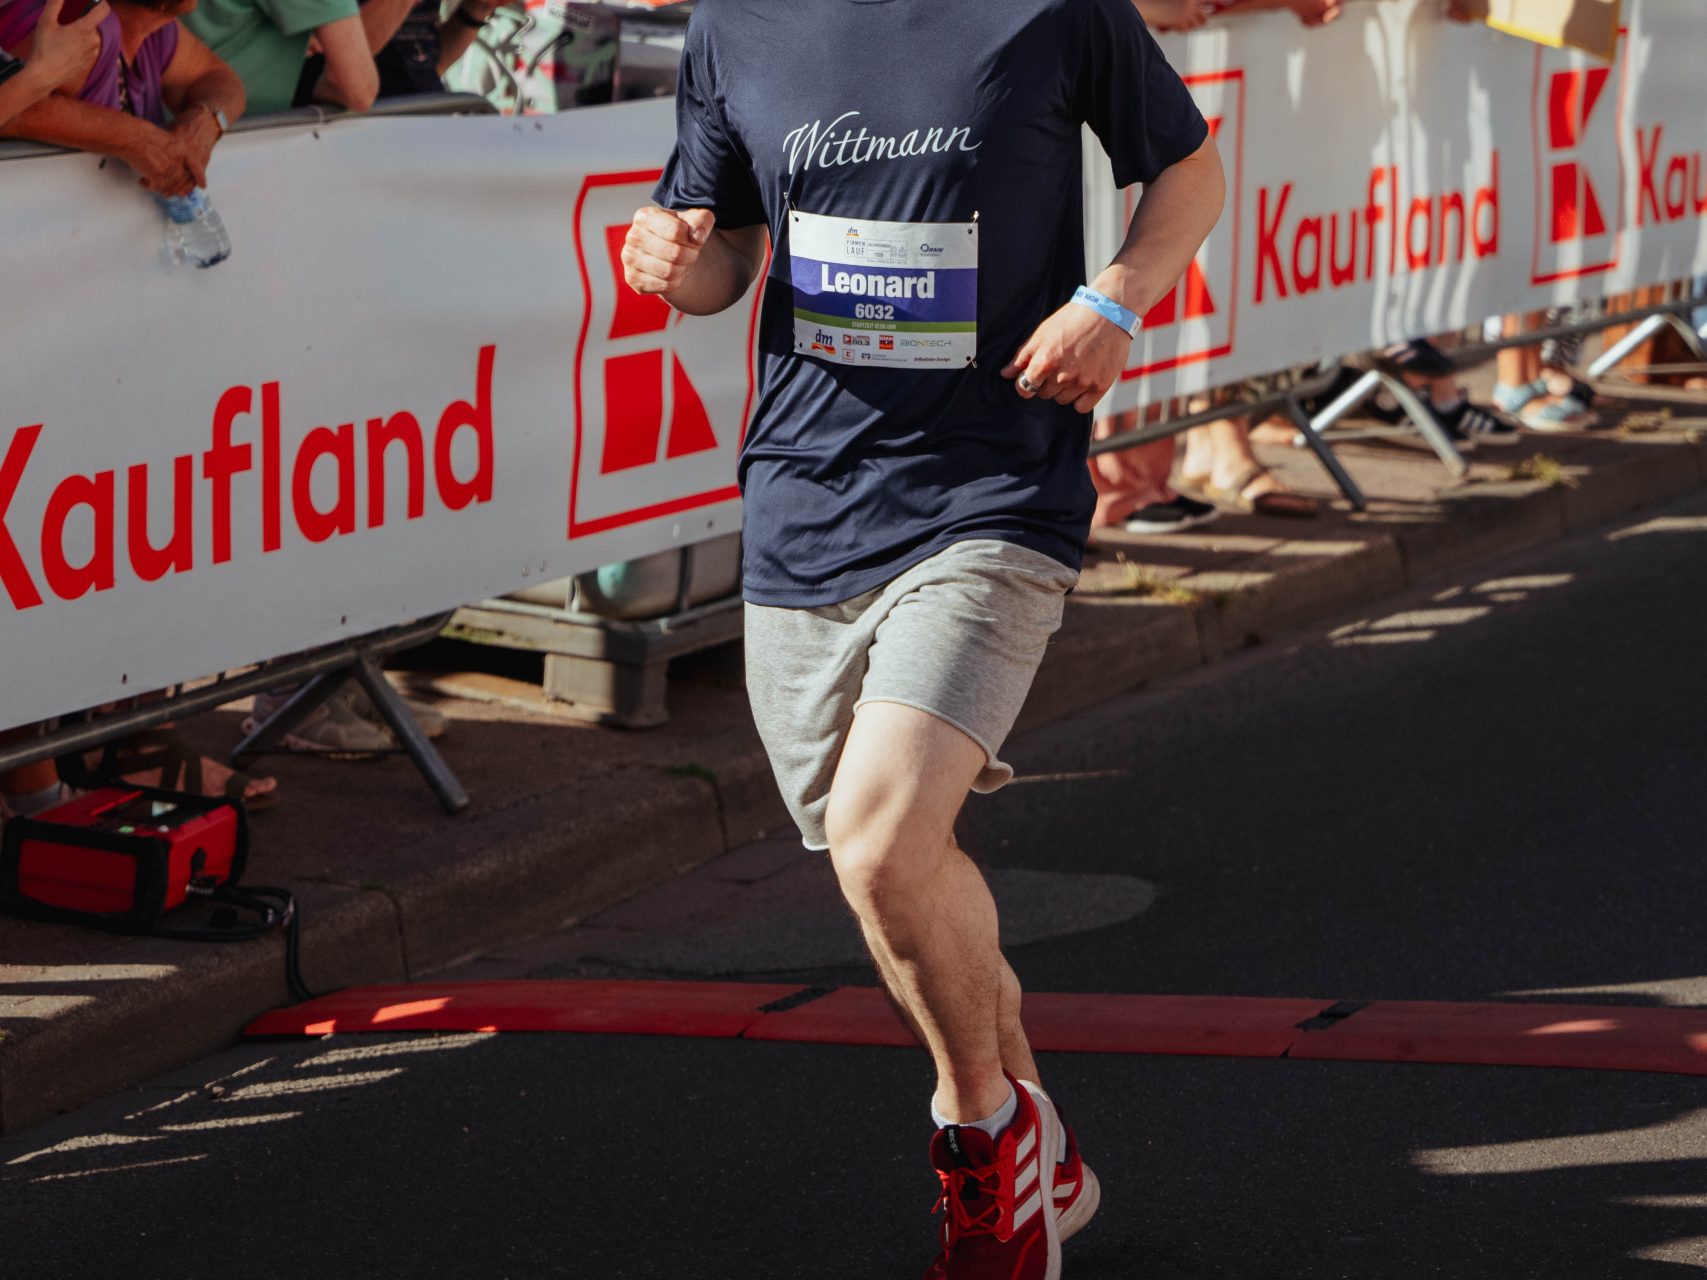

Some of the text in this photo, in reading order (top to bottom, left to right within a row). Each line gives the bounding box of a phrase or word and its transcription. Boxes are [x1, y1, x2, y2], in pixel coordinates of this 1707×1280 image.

[783, 111, 982, 174] Wittmann
[1253, 149, 1499, 304] Kaufland
[846, 247, 865, 256] LAUF
[821, 263, 935, 299] Leonard
[855, 303, 894, 320] 6032
[815, 329, 833, 345] dm
[900, 339, 952, 347] BIONTECH
